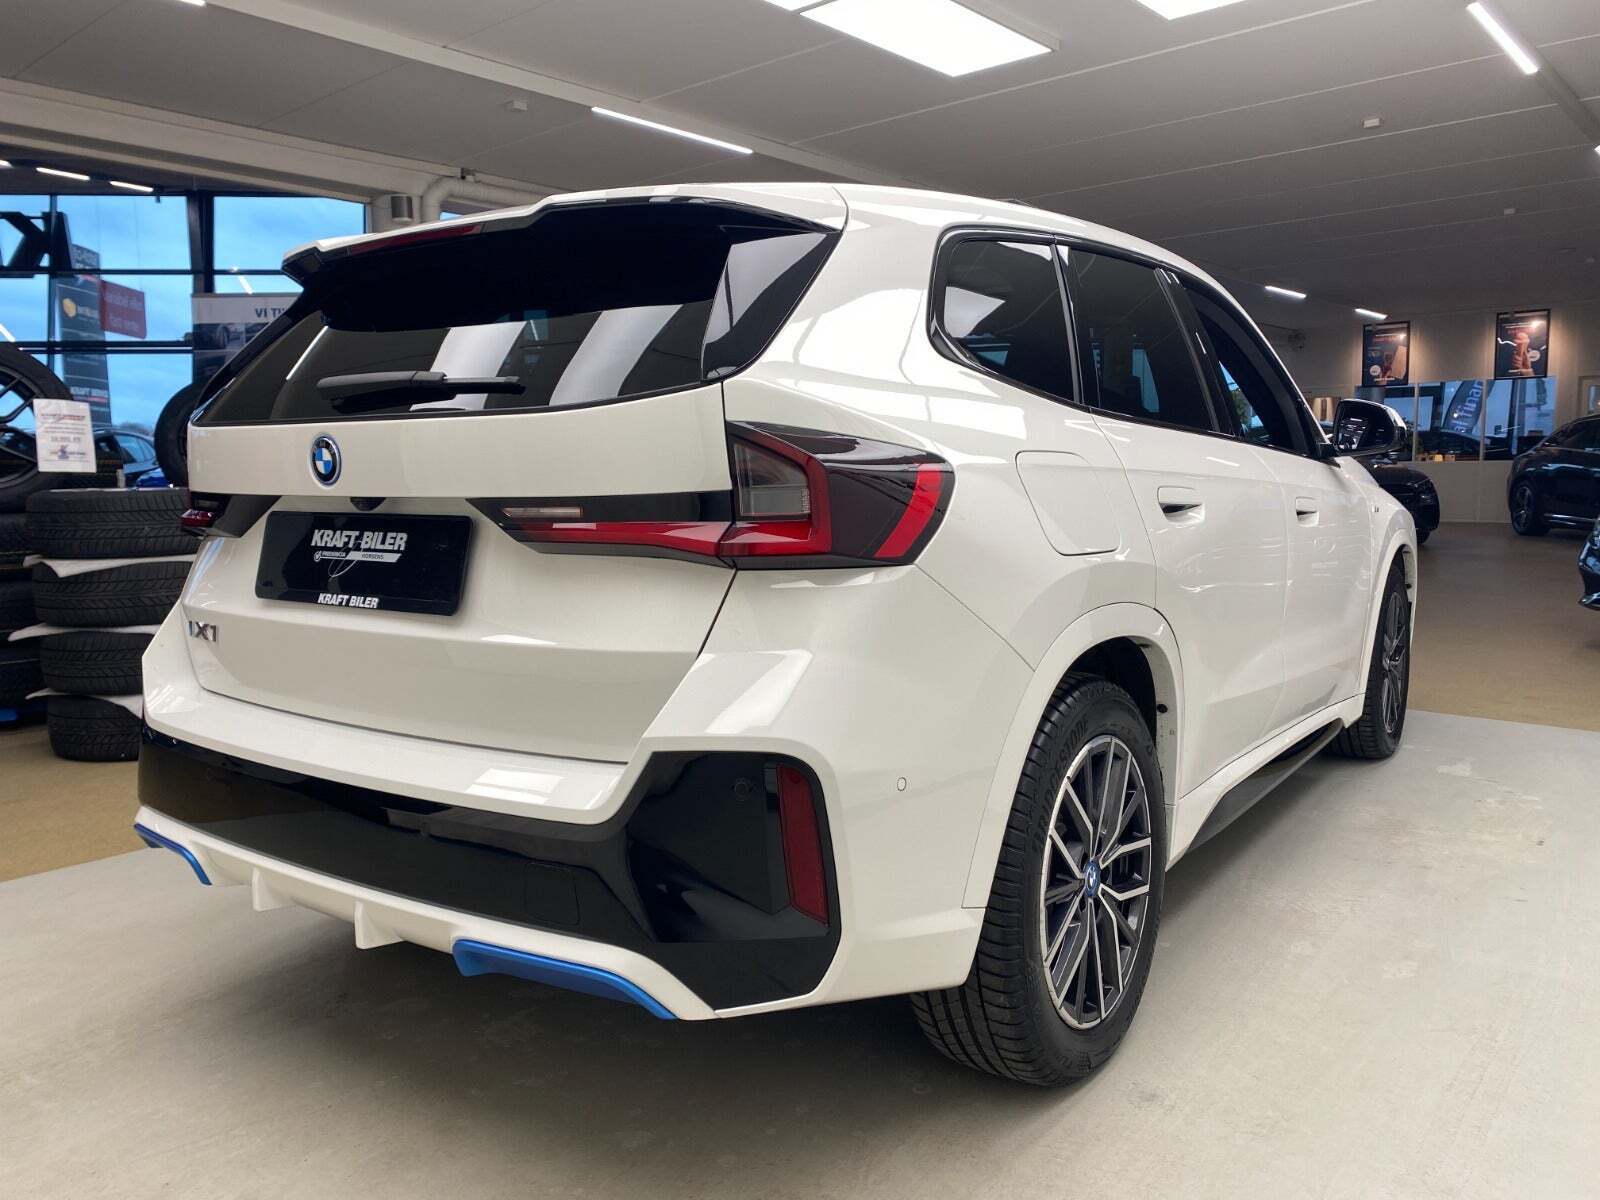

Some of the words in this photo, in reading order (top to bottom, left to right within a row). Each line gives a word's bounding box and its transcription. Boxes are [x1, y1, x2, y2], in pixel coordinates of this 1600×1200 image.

[254, 307, 267, 317] VI
[311, 529, 360, 548] KRAFT
[360, 531, 408, 550] BILER
[318, 593, 349, 606] KRAFT
[349, 596, 379, 609] BILER
